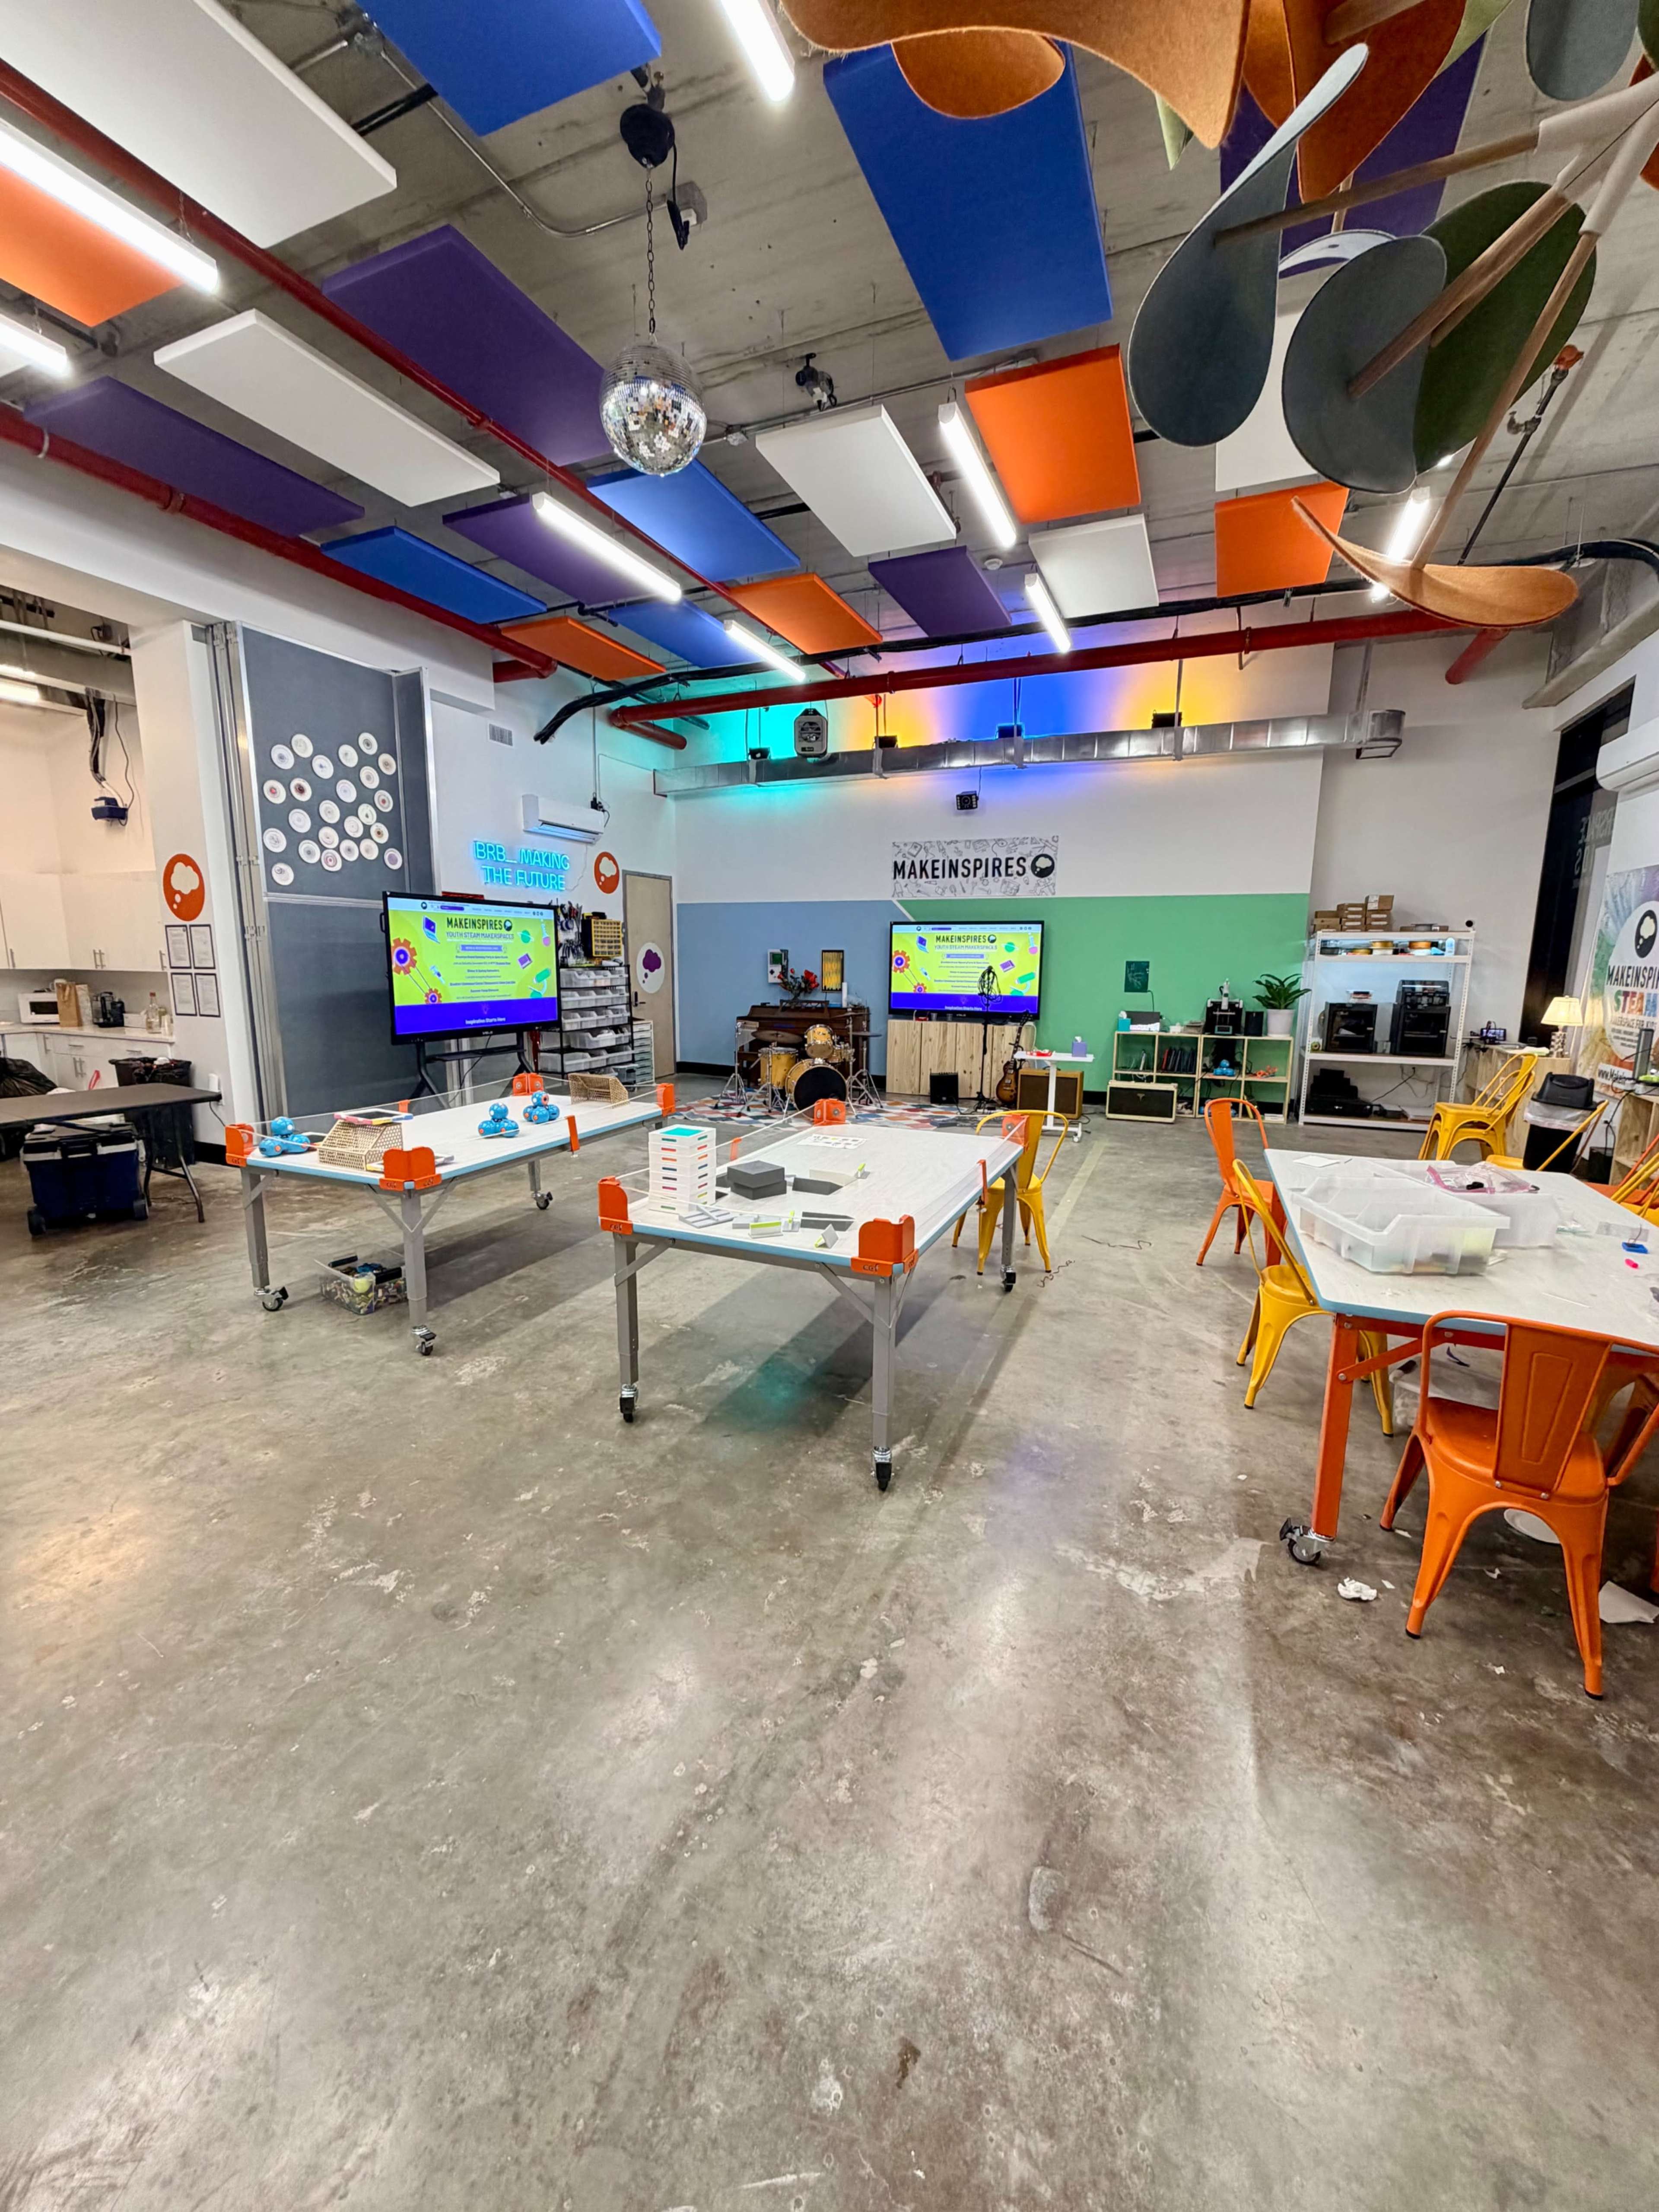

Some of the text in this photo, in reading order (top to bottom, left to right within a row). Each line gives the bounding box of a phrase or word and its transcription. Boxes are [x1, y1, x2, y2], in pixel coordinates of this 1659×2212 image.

[520, 848, 570, 870] MAKING
[893, 856, 1027, 880] MAKEINSPIRES
[481, 866, 566, 891] THE FUTURE
[447, 917, 503, 930] MAKEINSPIRES
[935, 935, 986, 943] MAKEINSPIRES
[1614, 990, 1658, 1017] STEAM
